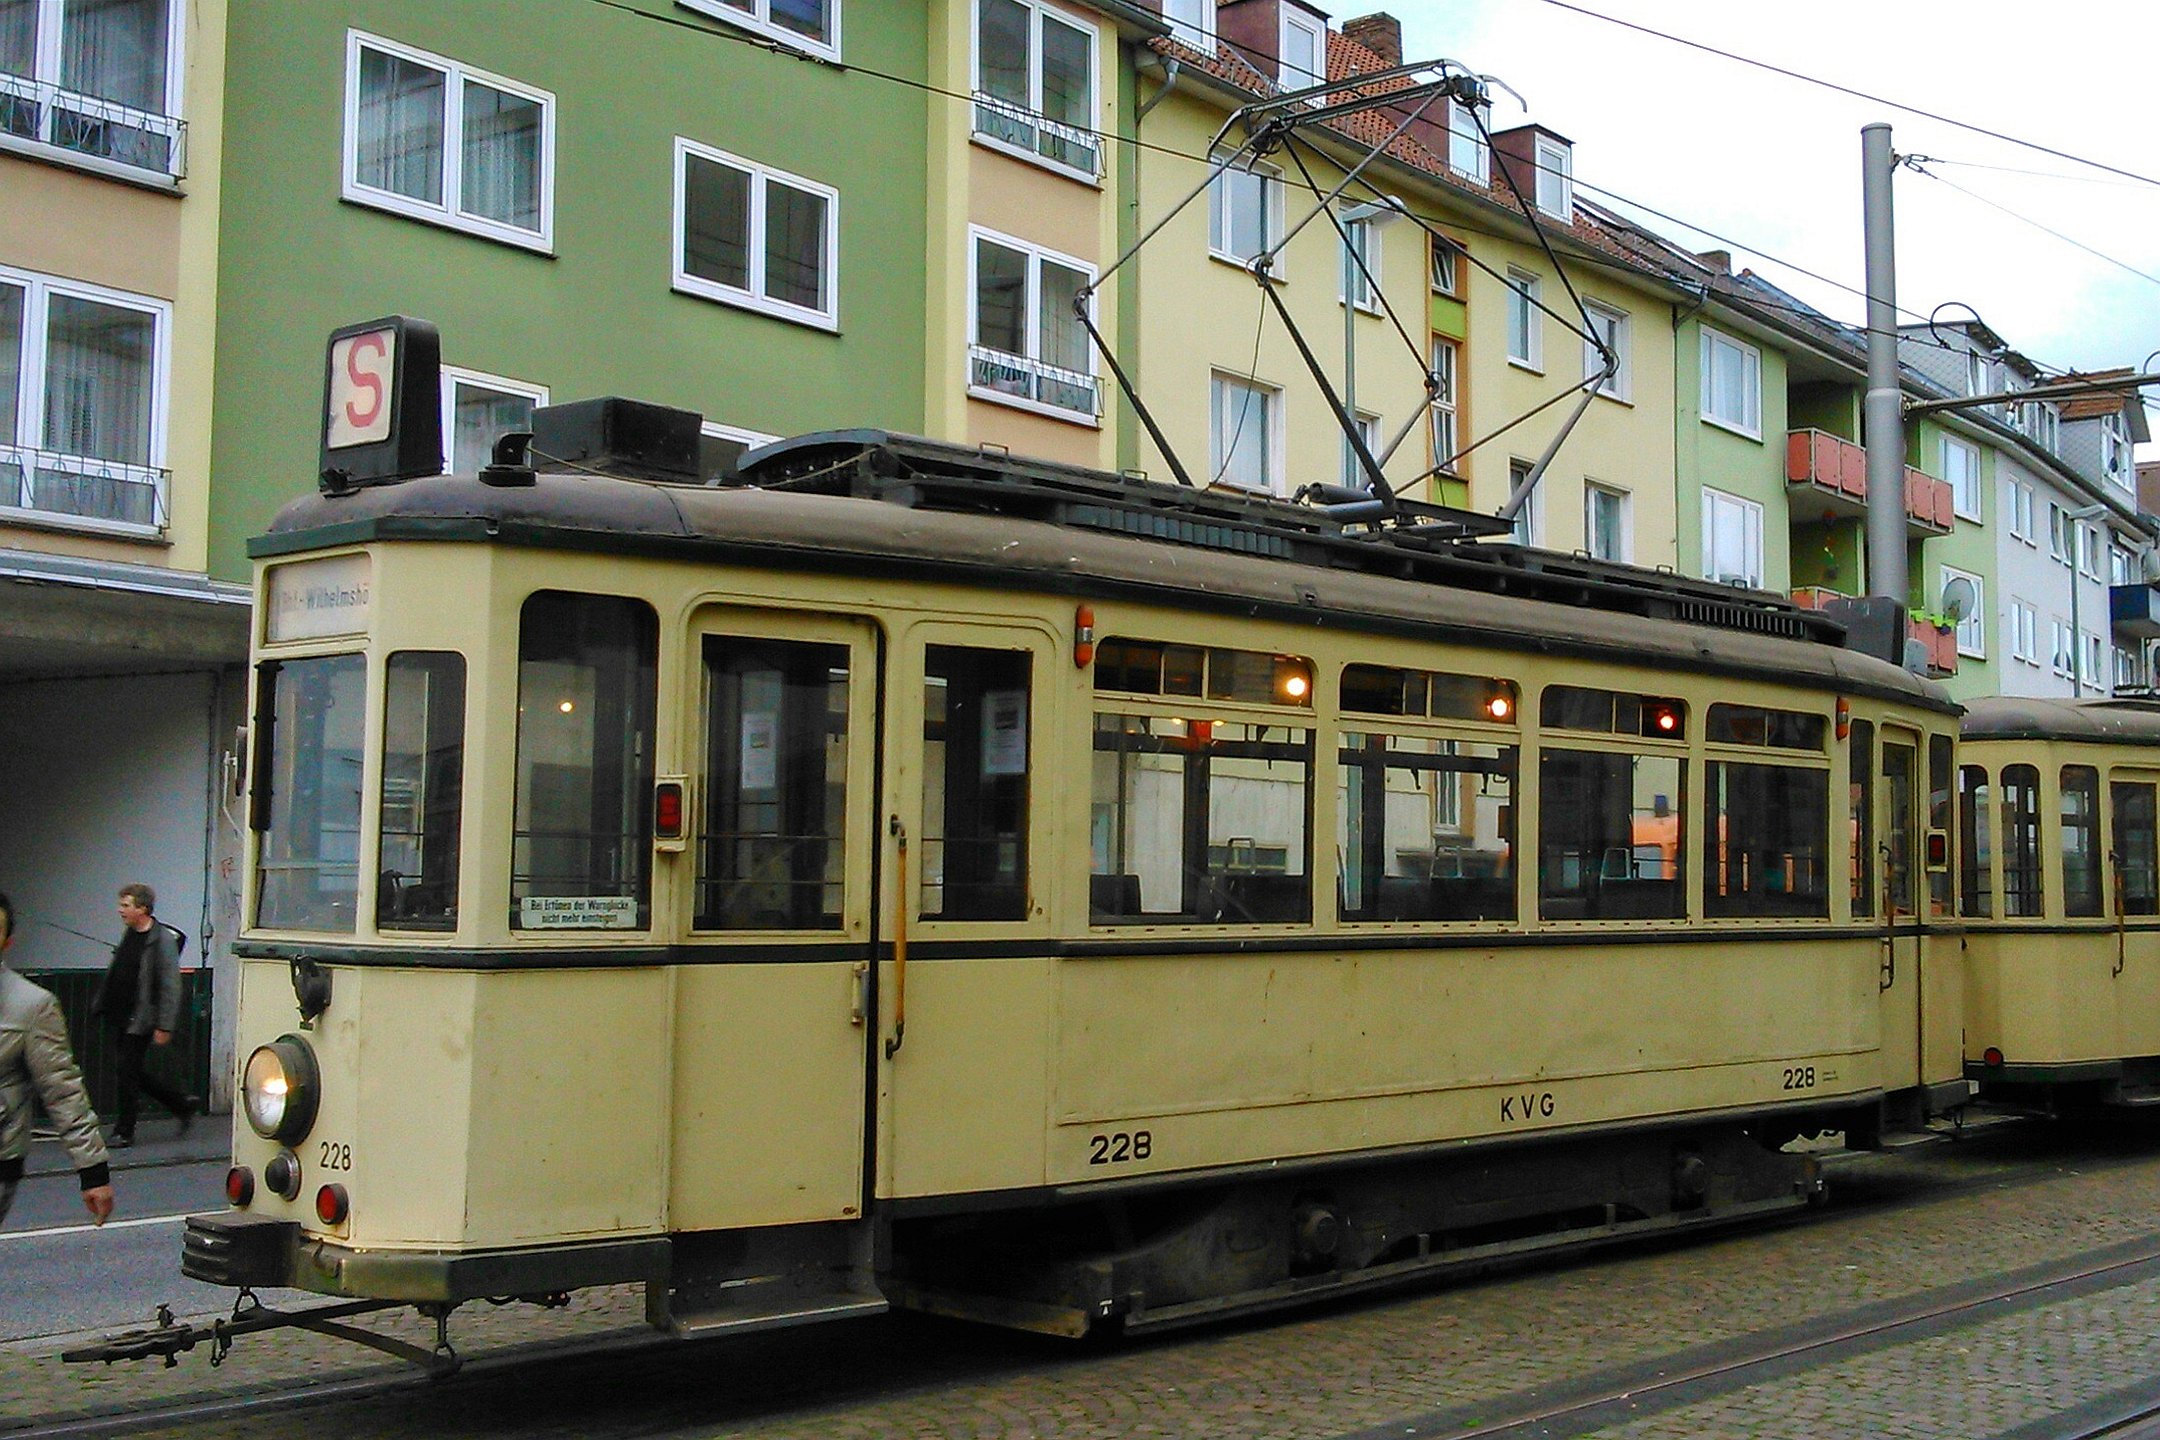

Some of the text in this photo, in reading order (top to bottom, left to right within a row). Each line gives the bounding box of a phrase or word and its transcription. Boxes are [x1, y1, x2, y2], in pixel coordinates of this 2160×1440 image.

[346, 333, 386, 428] S
[531, 900, 543, 911] Bei
[574, 900, 586, 911] der
[542, 914, 560, 923] nicht
[561, 914, 580, 923] mehr
[1783, 1066, 1815, 1090] 228
[320, 1141, 352, 1171] 228
[1090, 1130, 1152, 1165] 228
